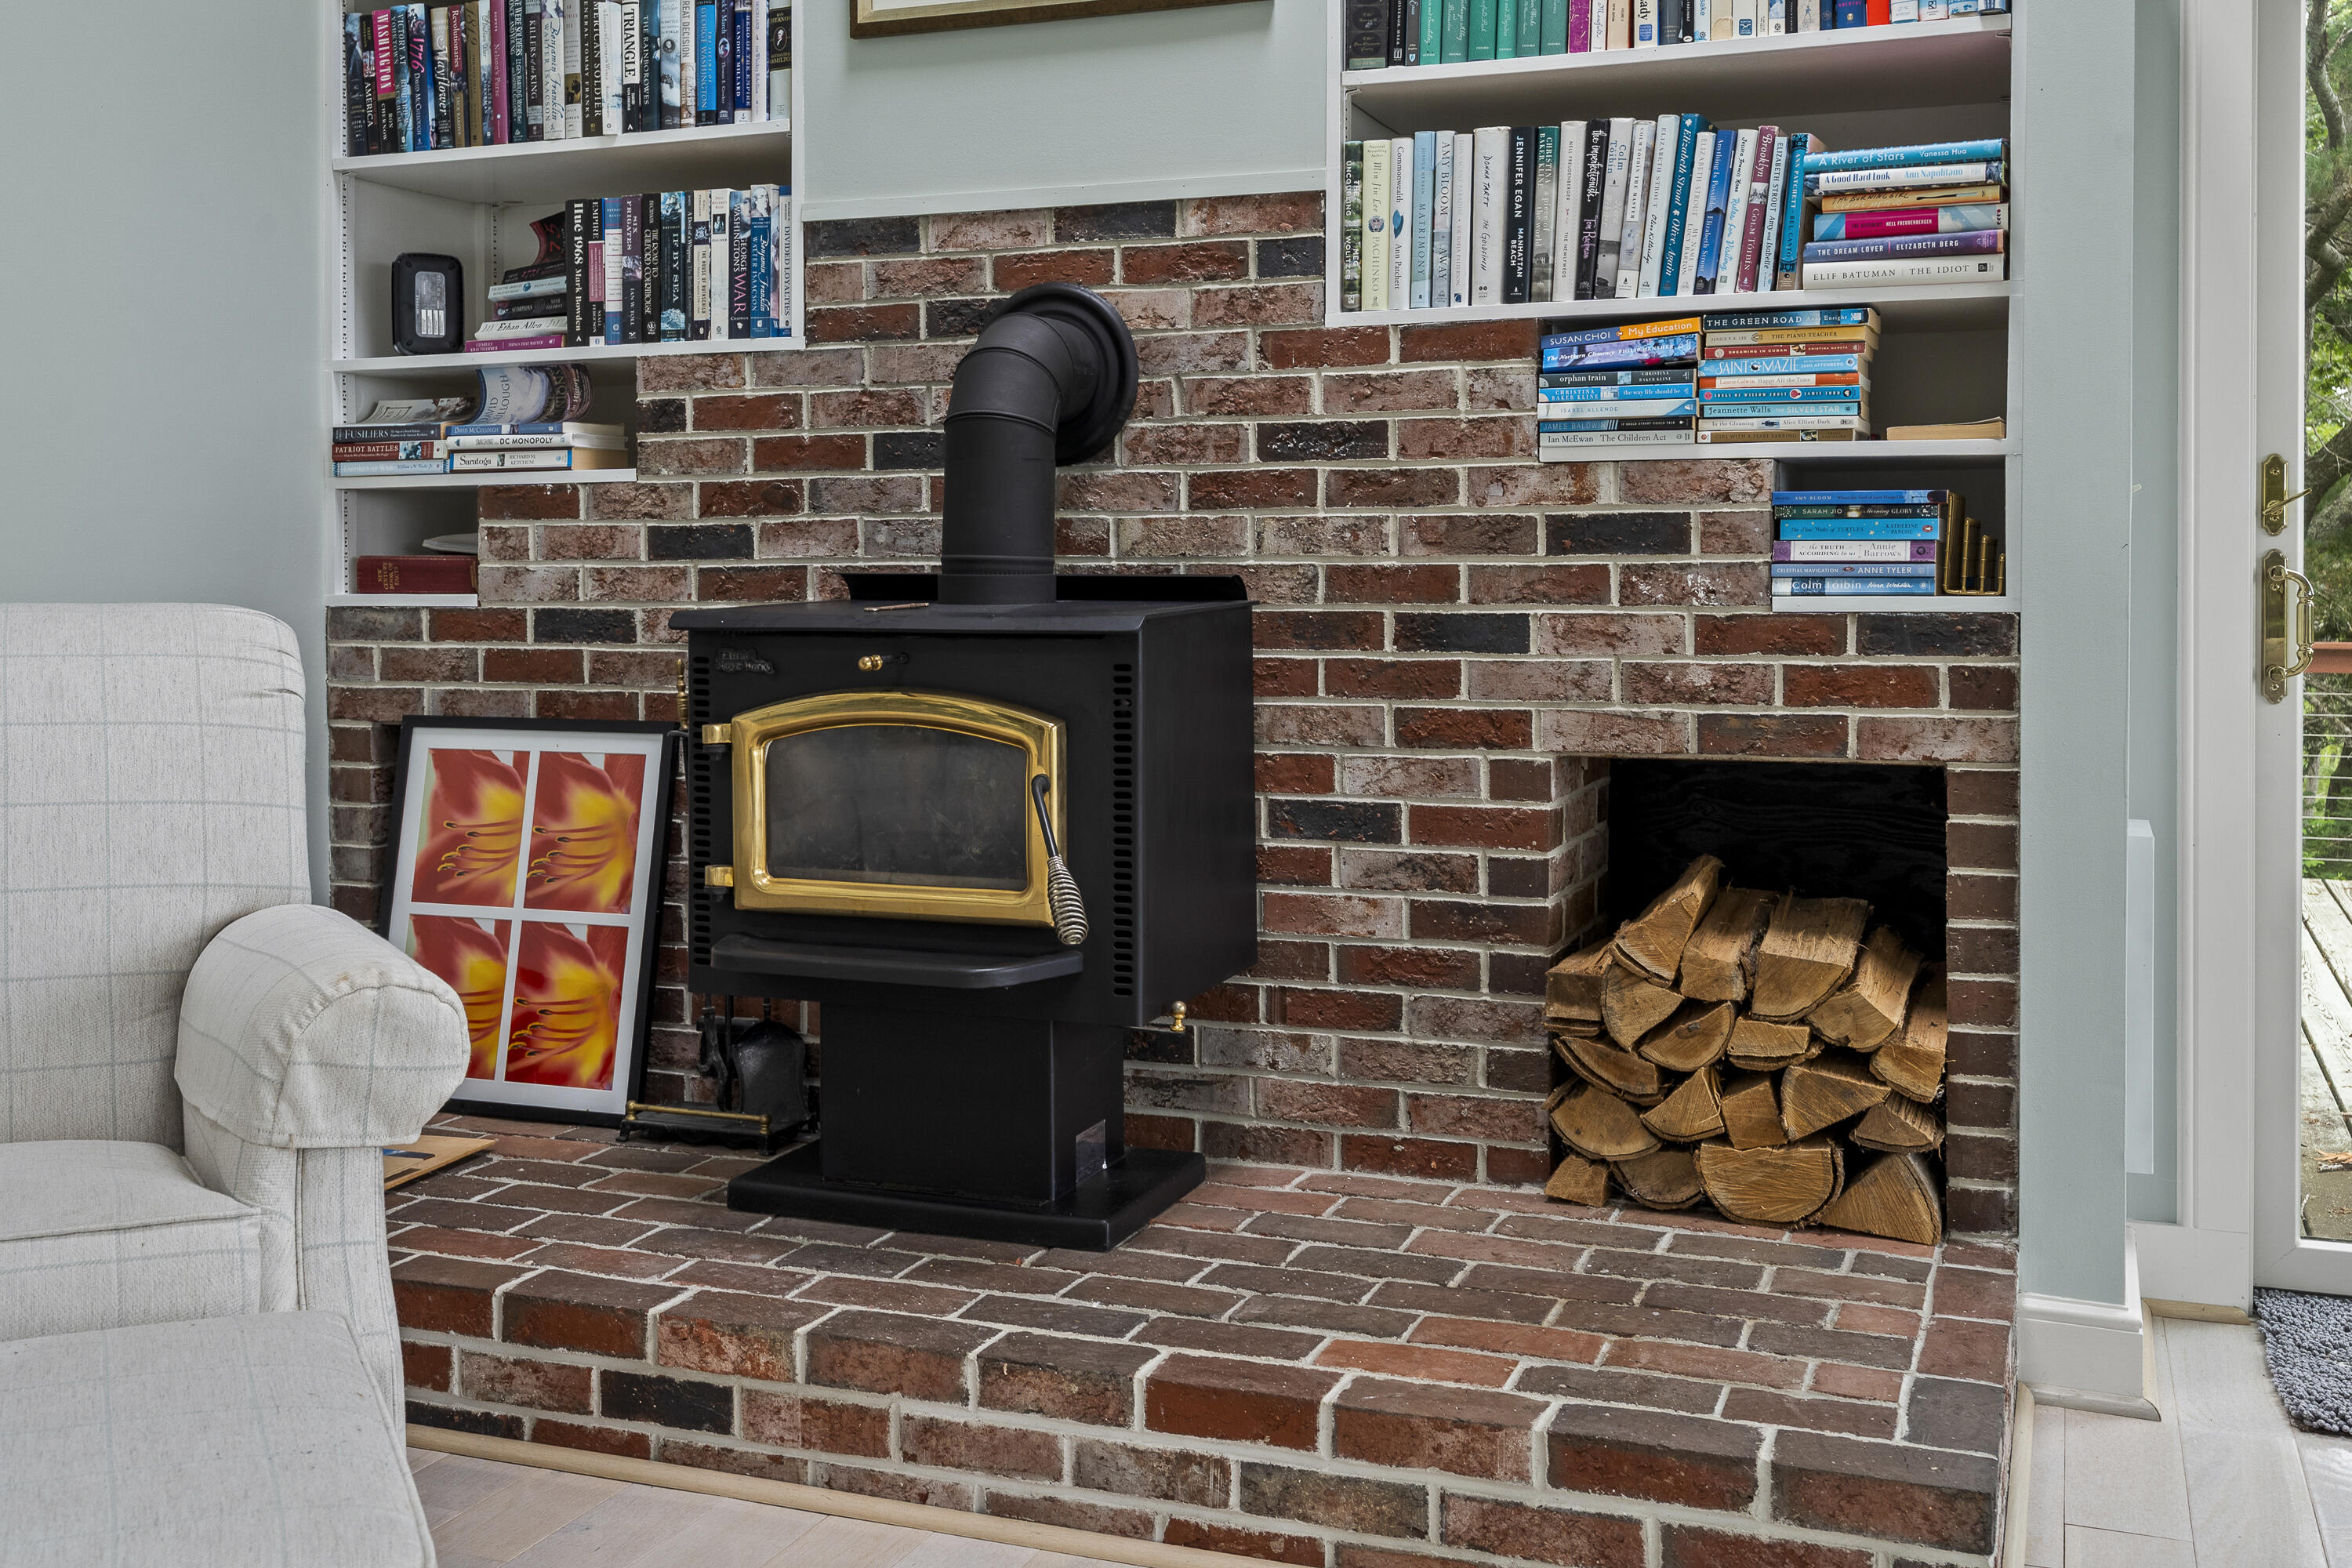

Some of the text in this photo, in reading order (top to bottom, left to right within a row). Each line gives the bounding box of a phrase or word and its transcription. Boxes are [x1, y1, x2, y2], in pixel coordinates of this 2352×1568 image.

[377, 14, 391, 89] WASHINGTON
[452, 10, 461, 67] Revolutionaries
[624, 9, 635, 78] TRIANGLE
[409, 38, 425, 73] 1776
[550, 18, 564, 120] Benjamin Franklin
[435, 36, 449, 116] Mayflower
[365, 82, 374, 127] AMERICA
[1515, 136, 1523, 186] JENNIFER
[1617, 145, 1626, 171] Colm
[1675, 128, 1692, 205] Elizabeth Strout
[1713, 139, 1724, 172] Anything
[1756, 134, 1771, 177] Brooklyn
[1819, 152, 1905, 166] A River of Stars
[1919, 149, 1949, 158] Vanessa
[1483, 156, 1492, 180] DONNA
[1769, 143, 1783, 212] ELIZABETH STROUT
[1831, 173, 1851, 183] Good
[1853, 172, 1871, 182] Hard
[1872, 172, 1890, 180] Look
[1904, 168, 1963, 179] Ann Napolitano
[673, 234, 678, 247] IF
[1700, 216, 1714, 271] Elizabeth Strout
[1719, 198, 1740, 270] Rules for Visiting
[1896, 241, 1936, 250] ELIZABETH
[574, 235, 583, 265] 1968
[673, 254, 678, 270] BY
[1763, 241, 1773, 269] Isabelle
[759, 227, 770, 312] Benjamin Franklin
[1439, 248, 1447, 281] AWAY
[1842, 270, 1896, 279] BATUMAN
[1937, 265, 1969, 274] IDIOT
[734, 273, 746, 314] WAR
[1550, 332, 1610, 345] SUSAN CHOI
[1628, 323, 1692, 337] My Education
[1715, 357, 1799, 375] SAINT MAZIE
[1708, 405, 1771, 415] Jeannette Walls
[345, 430, 388, 439] FUSILIERS
[460, 456, 491, 466] Saratoga
[1792, 581, 1821, 590] Colm
